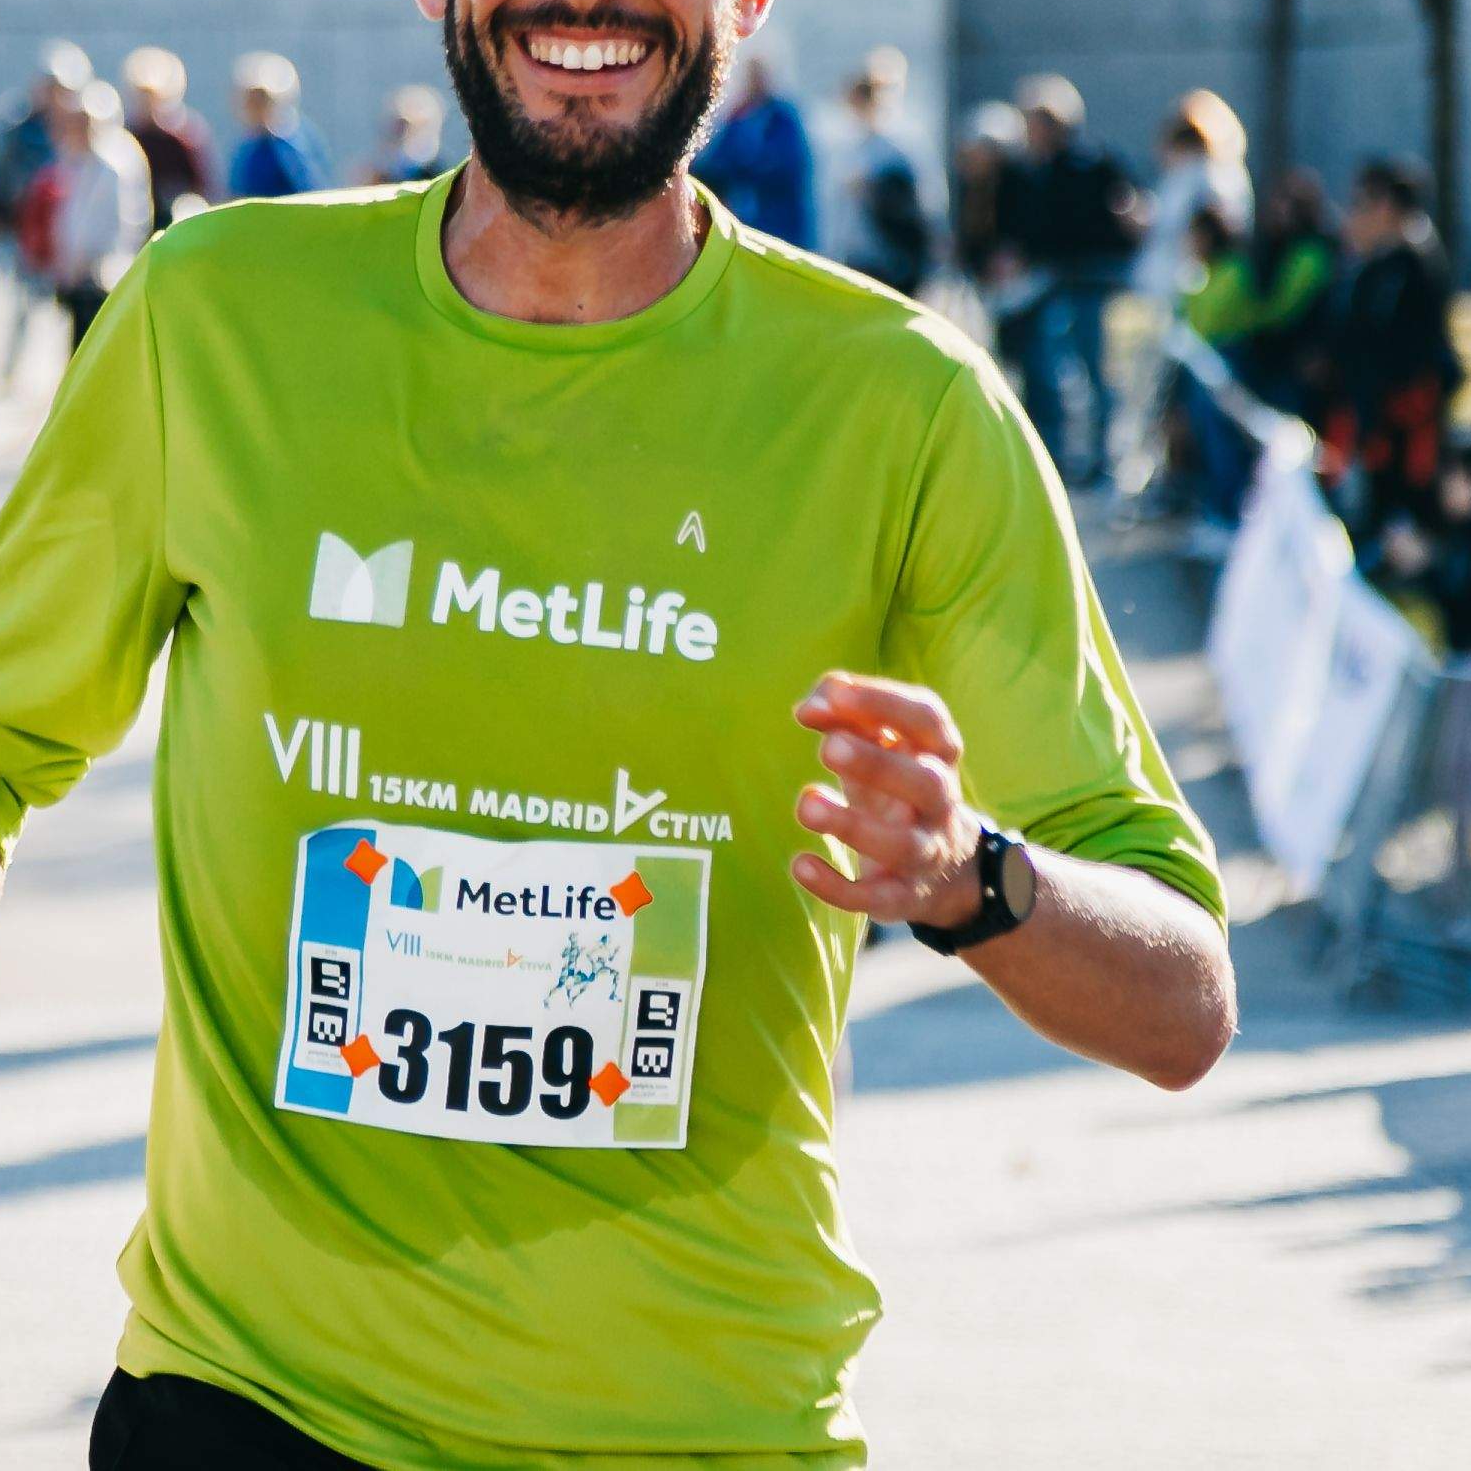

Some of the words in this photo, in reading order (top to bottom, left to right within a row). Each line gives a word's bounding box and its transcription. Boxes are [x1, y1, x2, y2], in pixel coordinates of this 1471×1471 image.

[432, 560, 719, 662] MetLife
[264, 713, 361, 800] VIII
[369, 775, 458, 812] 15KM
[469, 788, 610, 834] MADRID
[386, 929, 421, 957] VIII
[456, 878, 618, 921] MetLife
[378, 1008, 594, 1120] 3159
